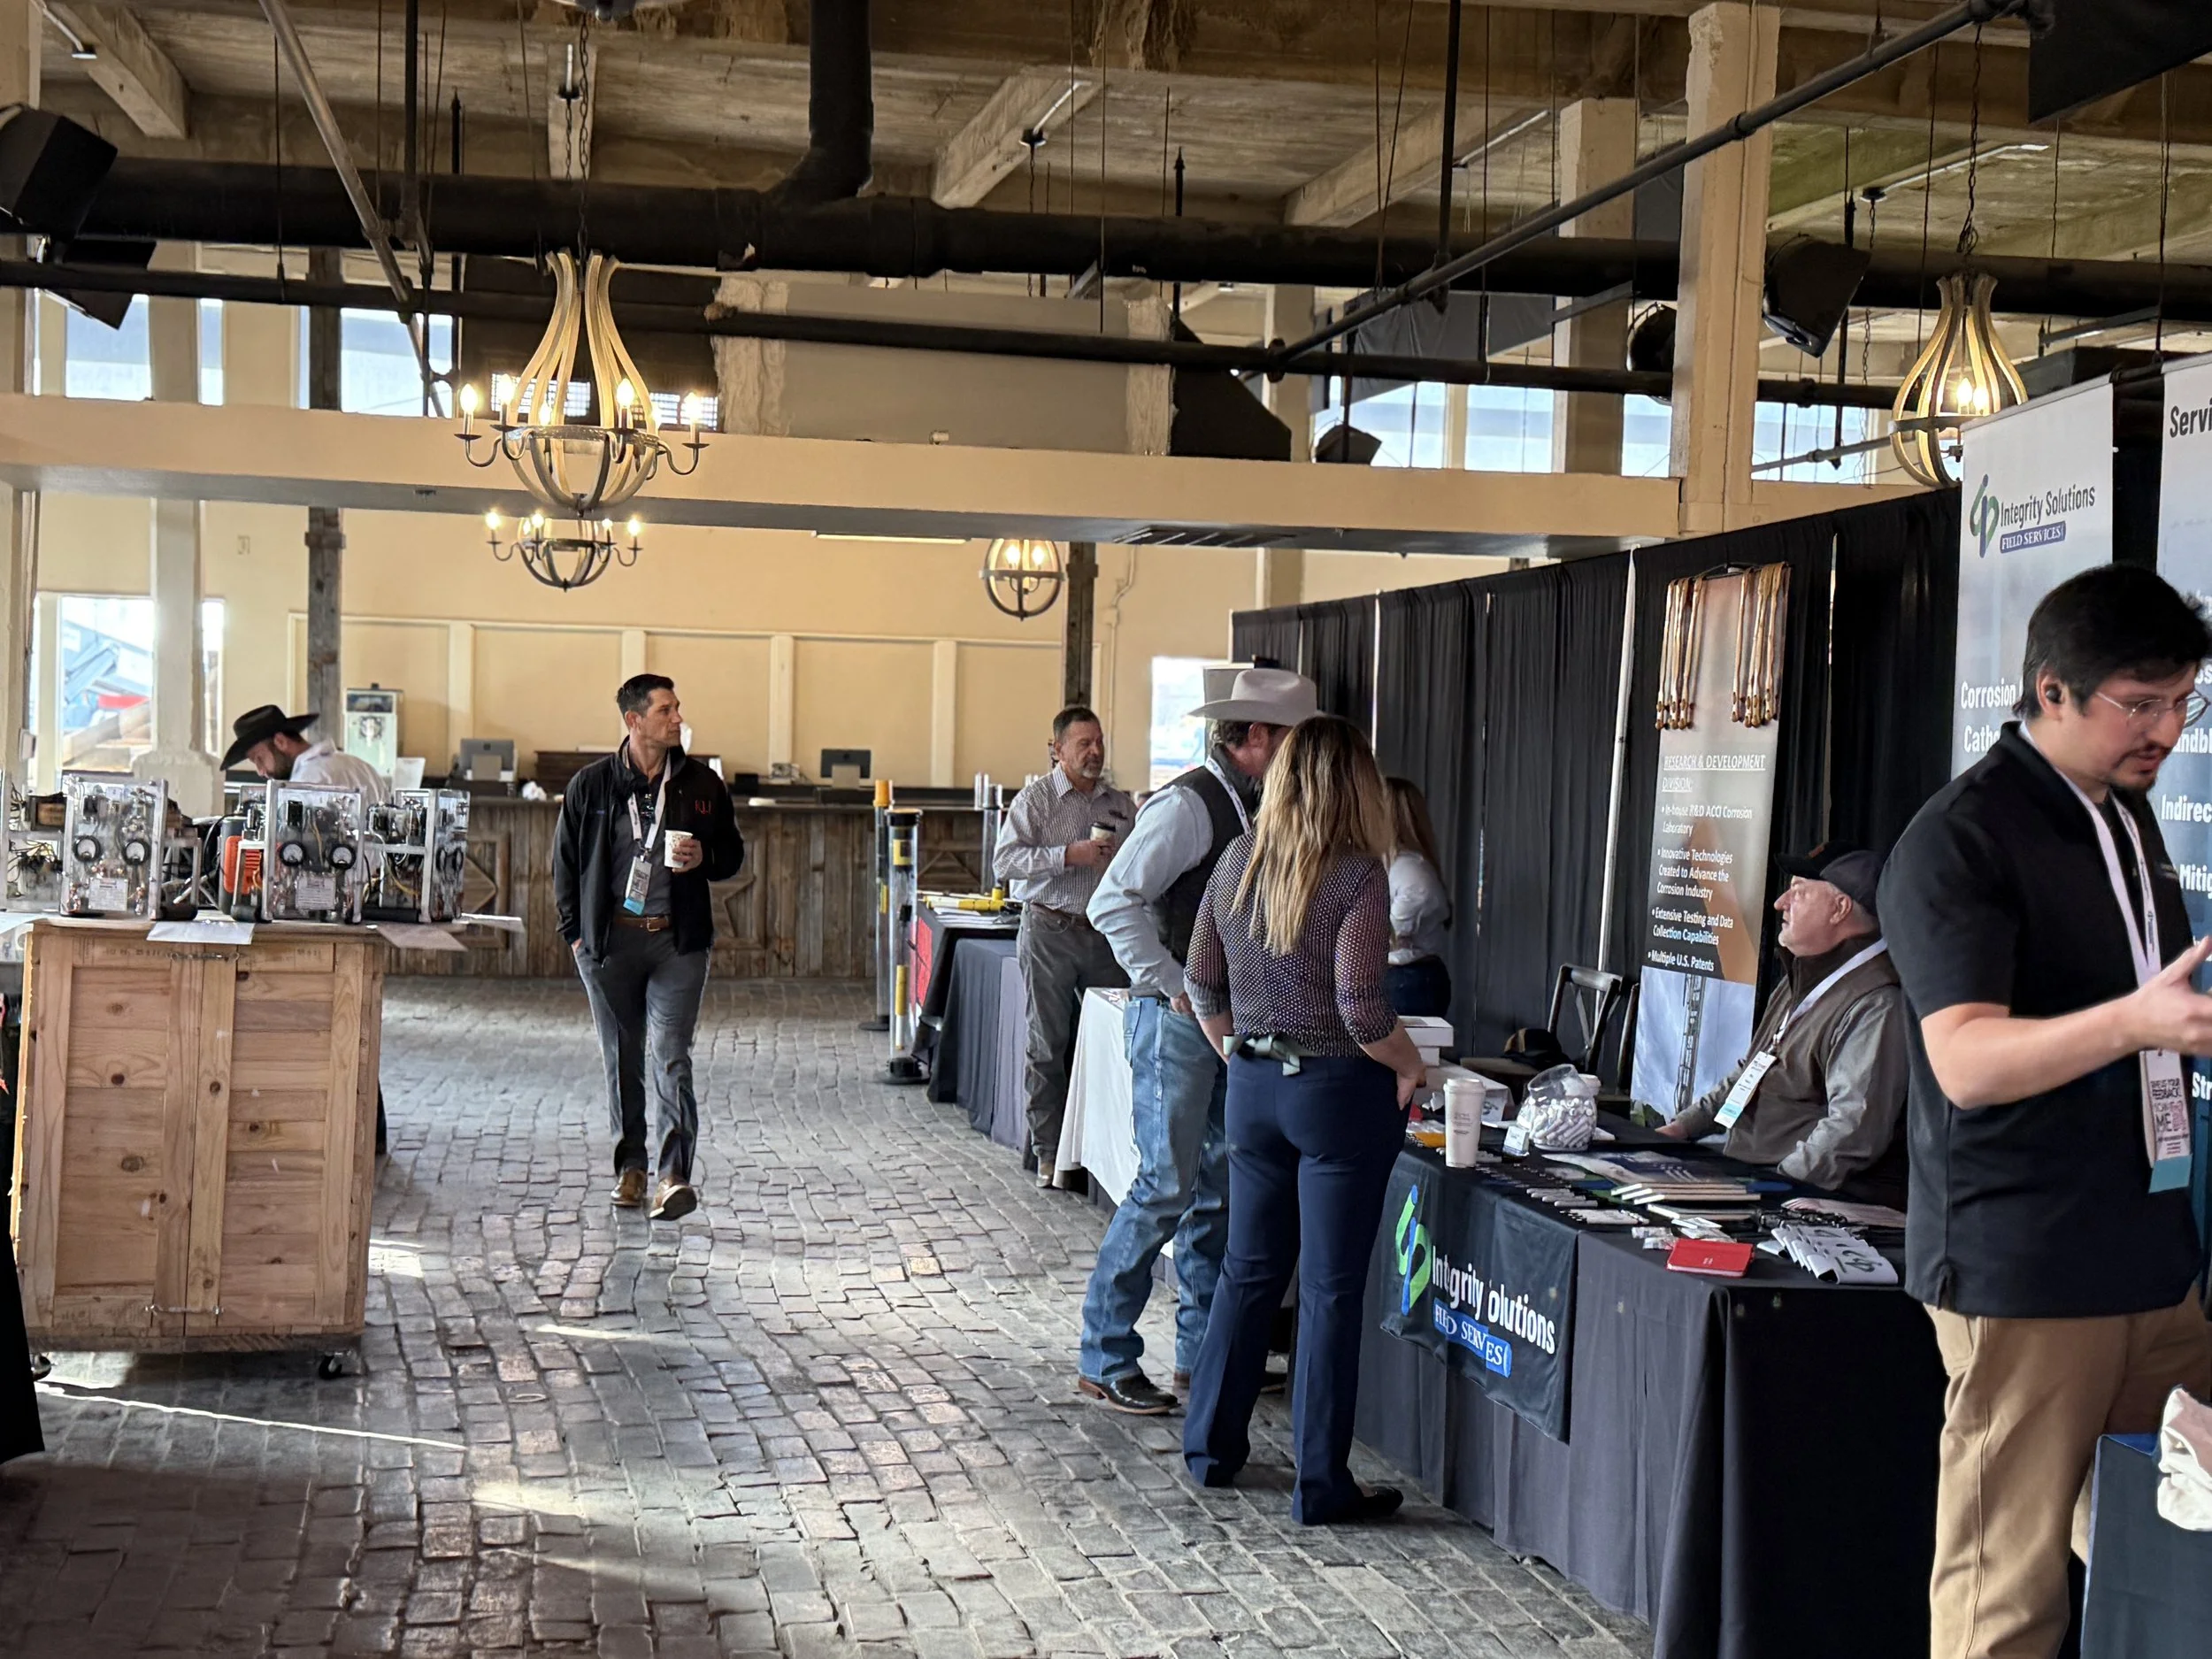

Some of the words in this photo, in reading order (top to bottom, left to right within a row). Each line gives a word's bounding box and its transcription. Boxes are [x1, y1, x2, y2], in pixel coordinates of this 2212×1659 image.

[2001, 495, 2043, 528] Integrity
[2046, 484, 2095, 516] Solutions
[2001, 534, 2023, 550] FIELD
[2024, 526, 2061, 545] SERVICES
[1961, 678, 2016, 709] Corrosion
[1663, 755, 1696, 769] RESEARCH
[1706, 754, 1766, 769] DEVELOPMENT
[1689, 804, 1704, 818] R&D
[1723, 806, 1753, 820] Corrosion
[1663, 820, 1694, 837] Laboratory
[1661, 847, 1690, 861] Innovative
[1692, 849, 1732, 866] Technologies
[1658, 864, 1680, 877] Created
[1681, 866, 1688, 879] to
[1689, 867, 1717, 881] Advance
[1718, 869, 1730, 882] the
[1657, 881, 1685, 896] Corrosion
[1685, 884, 1713, 902] Industry
[1655, 907, 1682, 922] Extensive
[1683, 910, 1706, 928] Testing
[1707, 913, 1719, 927] and
[1719, 914, 1734, 929] Data
[1653, 925, 1682, 940] Collection
[1682, 928, 1719, 946] Capabilities
[1651, 949, 1676, 966] Multiple
[1676, 953, 1690, 968] U.S.
[1691, 956, 1715, 972] Patents
[1487, 1279, 1555, 1355] olutions
